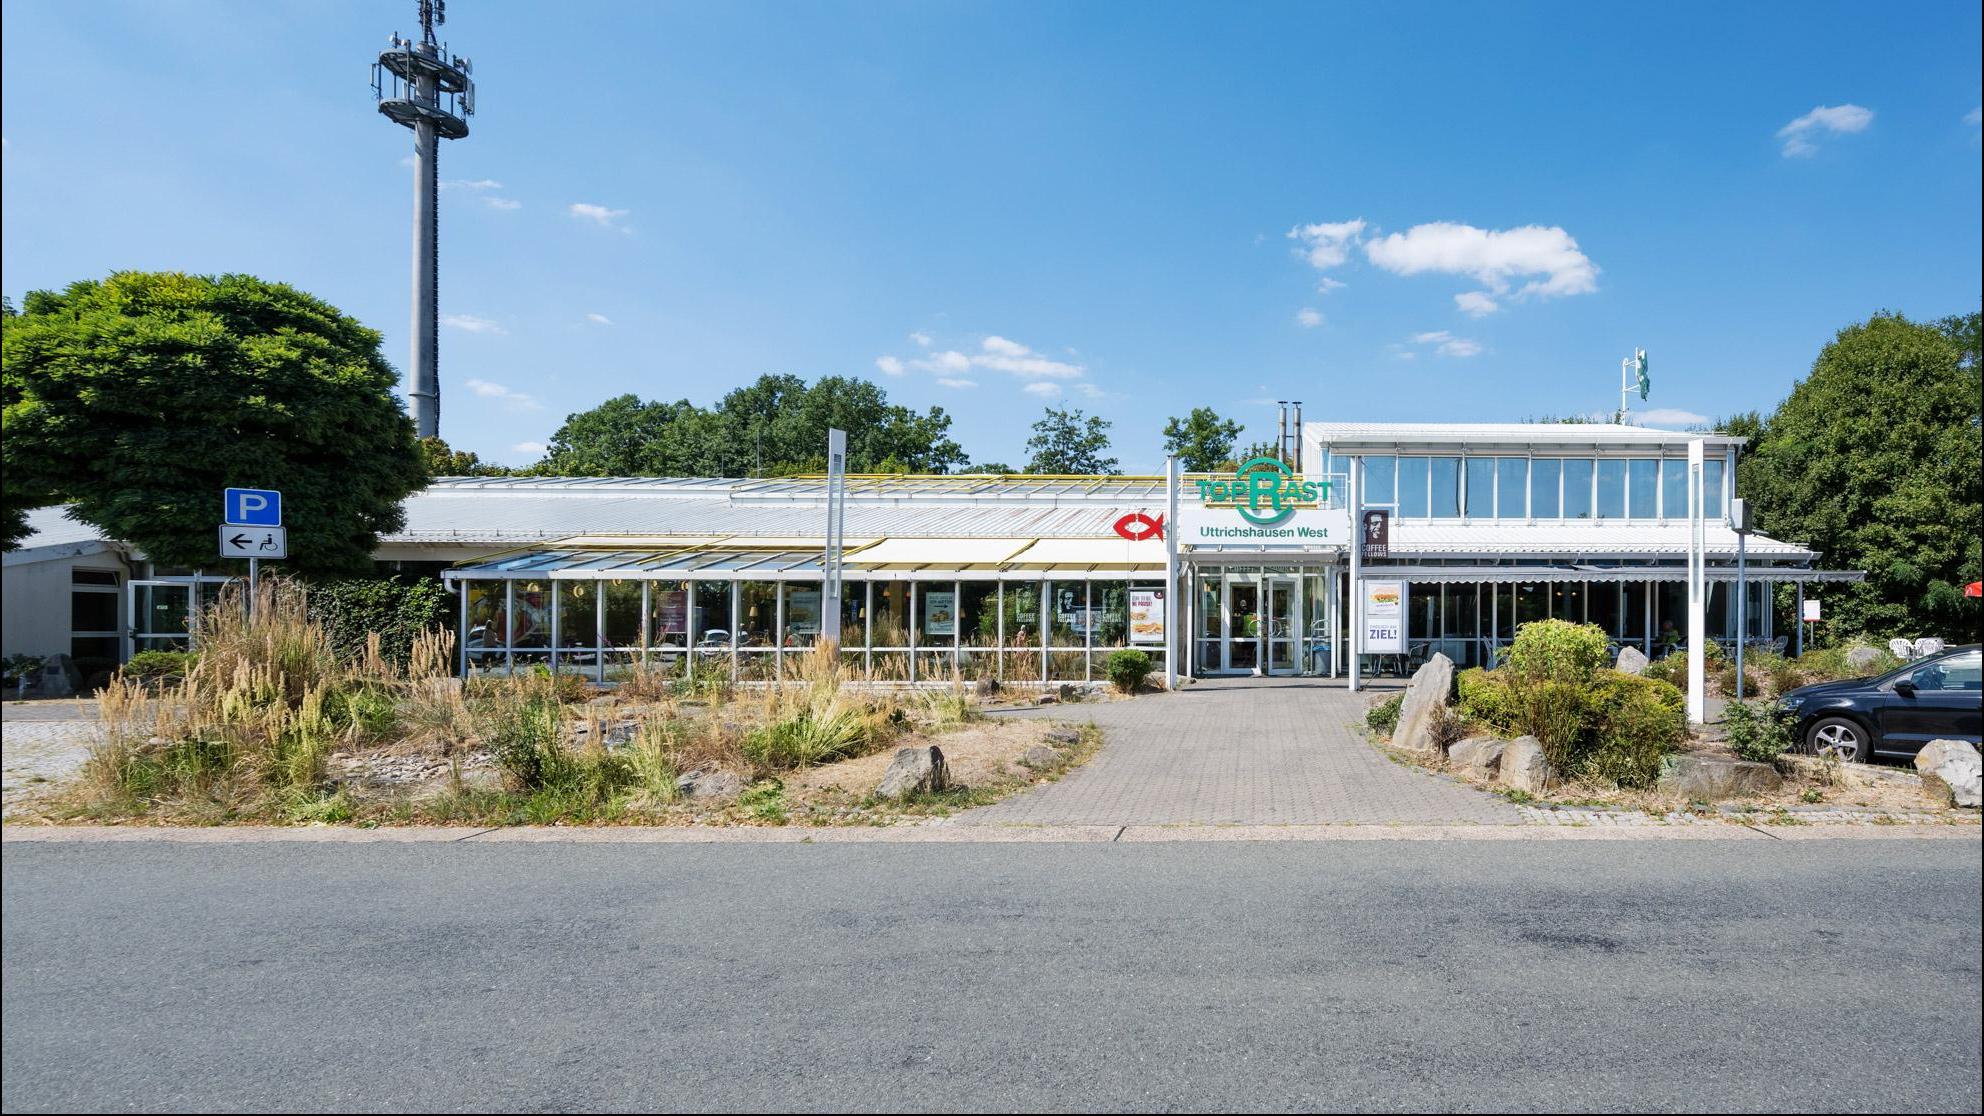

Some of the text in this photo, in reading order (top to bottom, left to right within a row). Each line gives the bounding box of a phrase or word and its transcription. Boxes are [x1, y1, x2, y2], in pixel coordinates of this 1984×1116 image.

[240, 494, 268, 520] P
[1200, 526, 1328, 538] Uttrichshausen West
[1361, 544, 1387, 552] COFFEE
[1369, 629, 1397, 639] ZIEL!
